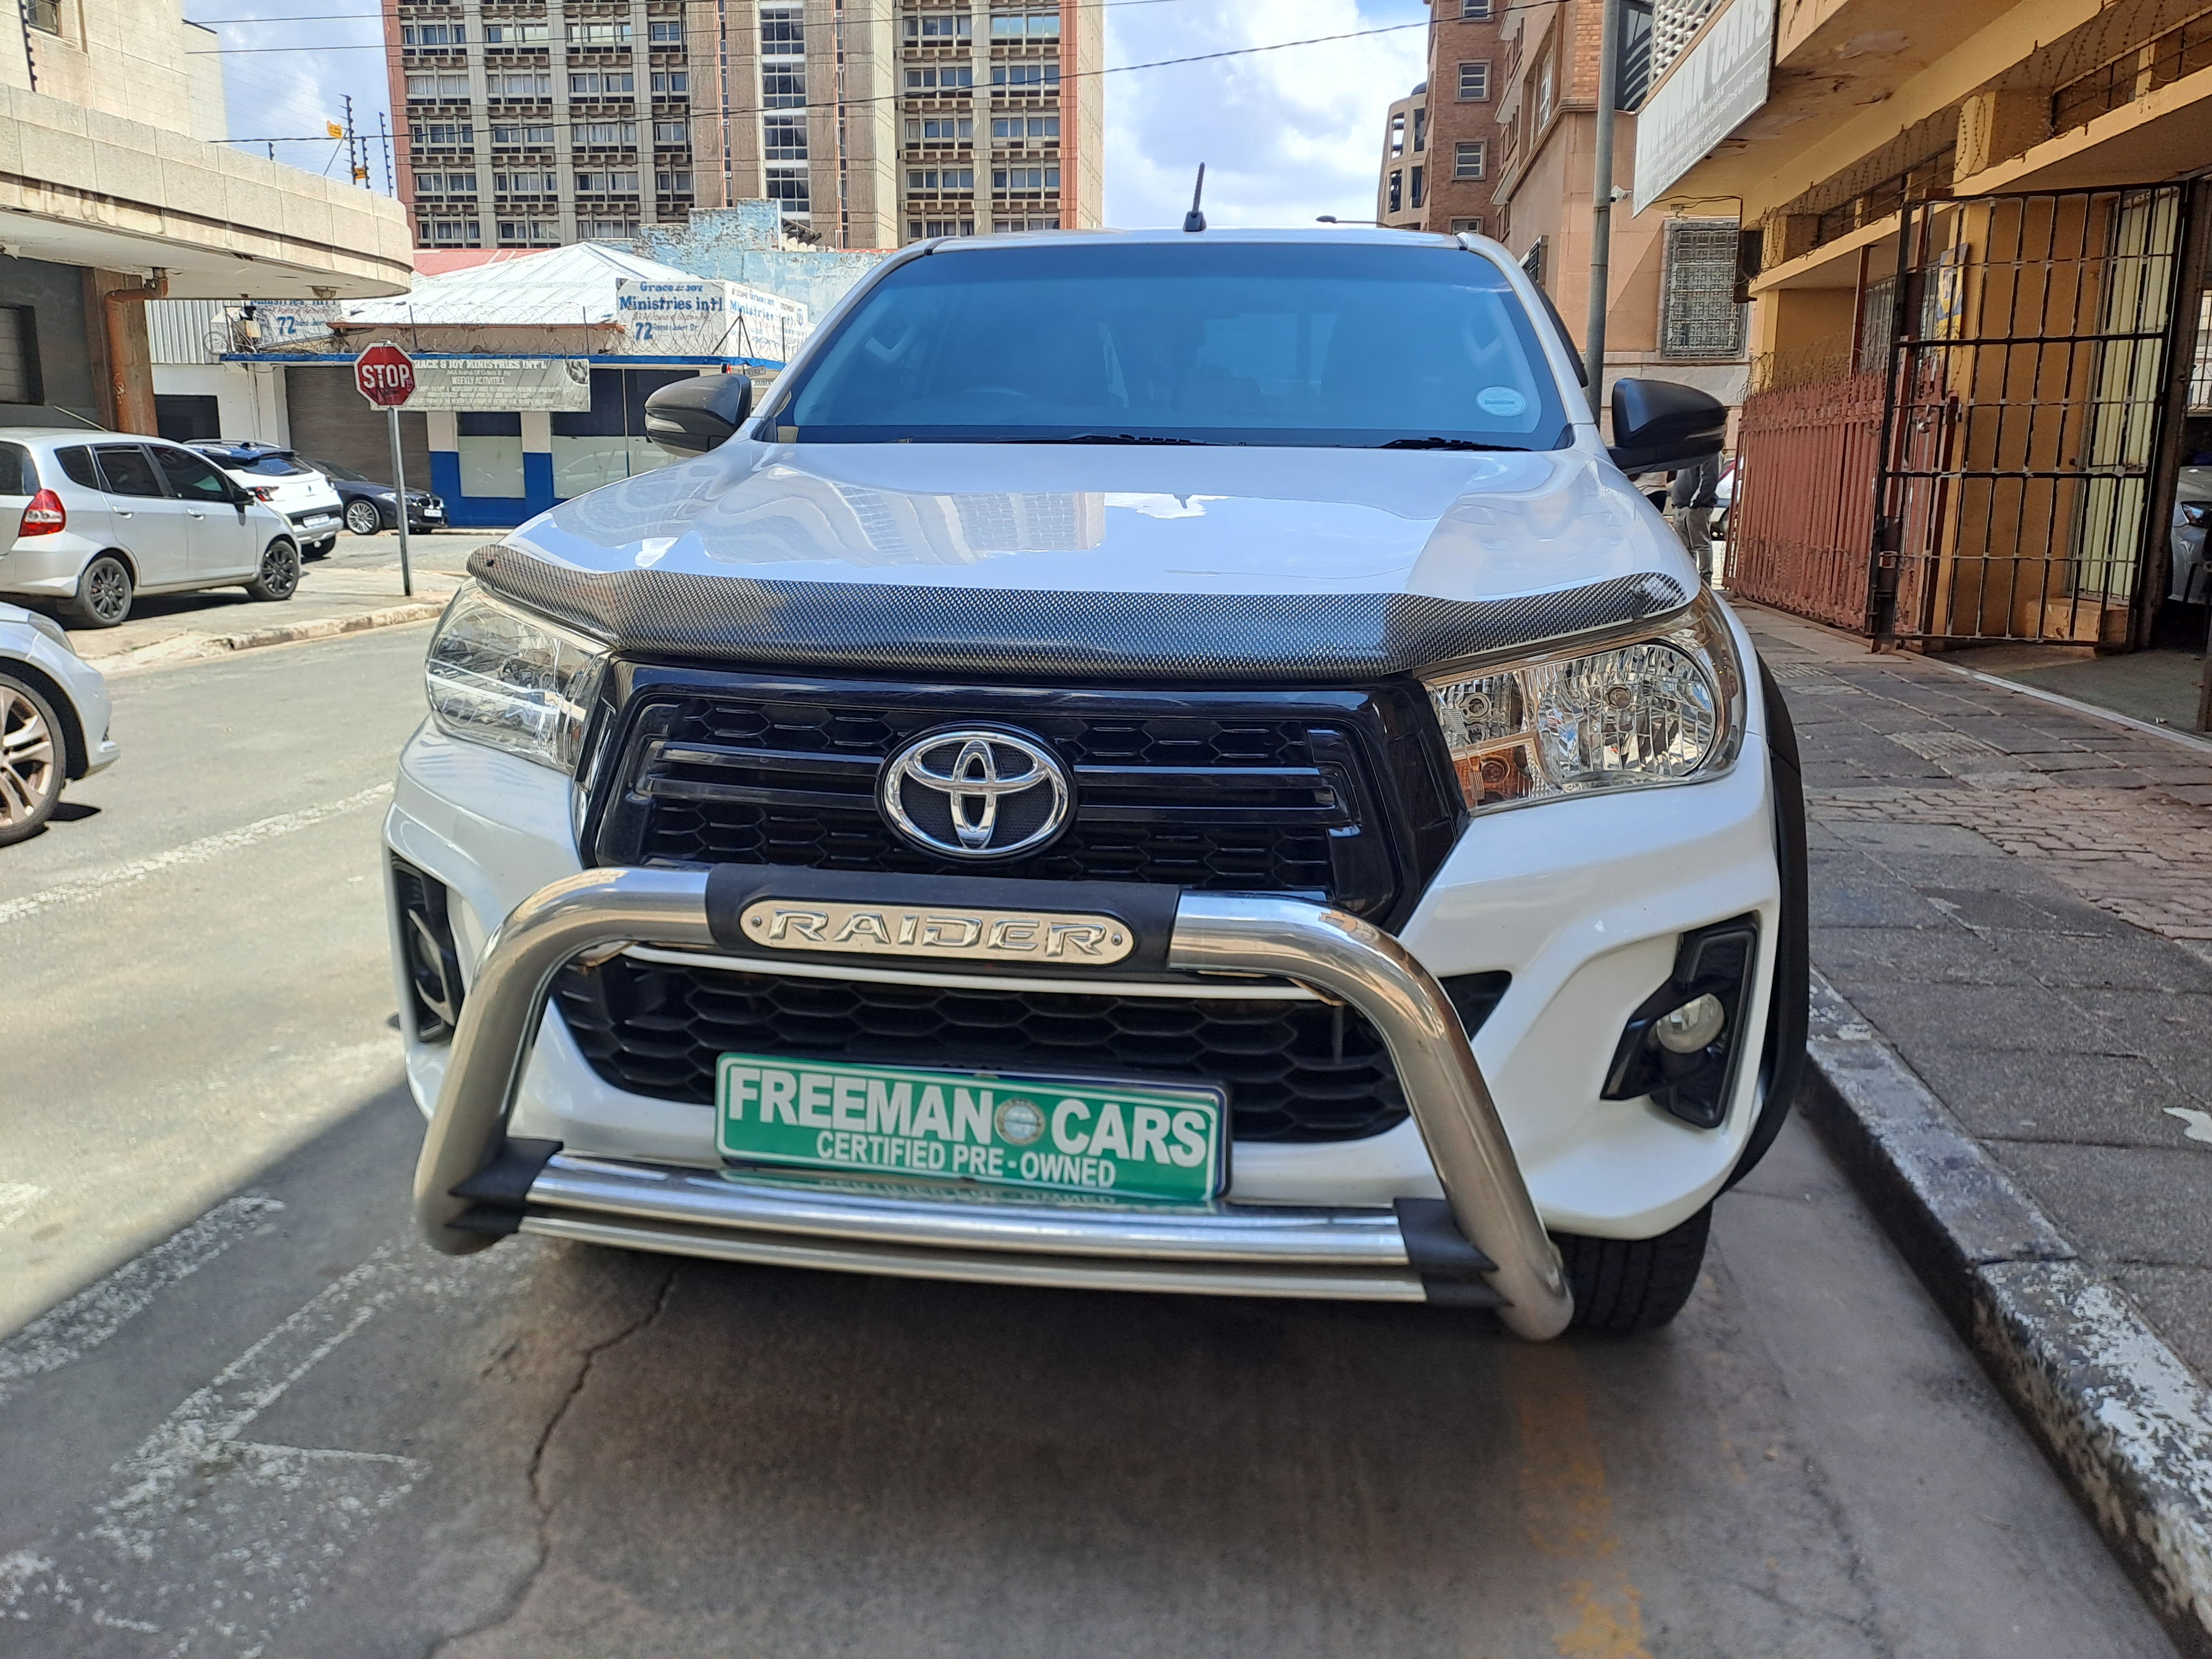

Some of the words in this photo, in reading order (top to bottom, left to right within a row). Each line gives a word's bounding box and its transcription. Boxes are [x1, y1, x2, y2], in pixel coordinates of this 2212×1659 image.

[619, 295, 692, 310] Ministries
[278, 316, 296, 335] 72
[635, 322, 653, 341] 72
[414, 360, 439, 369] RACE
[449, 360, 463, 369] JOY
[467, 360, 520, 369] MINISTRIES
[362, 364, 409, 389] STOP
[451, 377, 474, 385] WEEKLY
[768, 910, 1107, 957] RAIDER
[728, 1066, 993, 1145] FREEMAN
[1051, 1098, 1207, 1168] CARS
[816, 1130, 946, 1172] CERTIFIED
